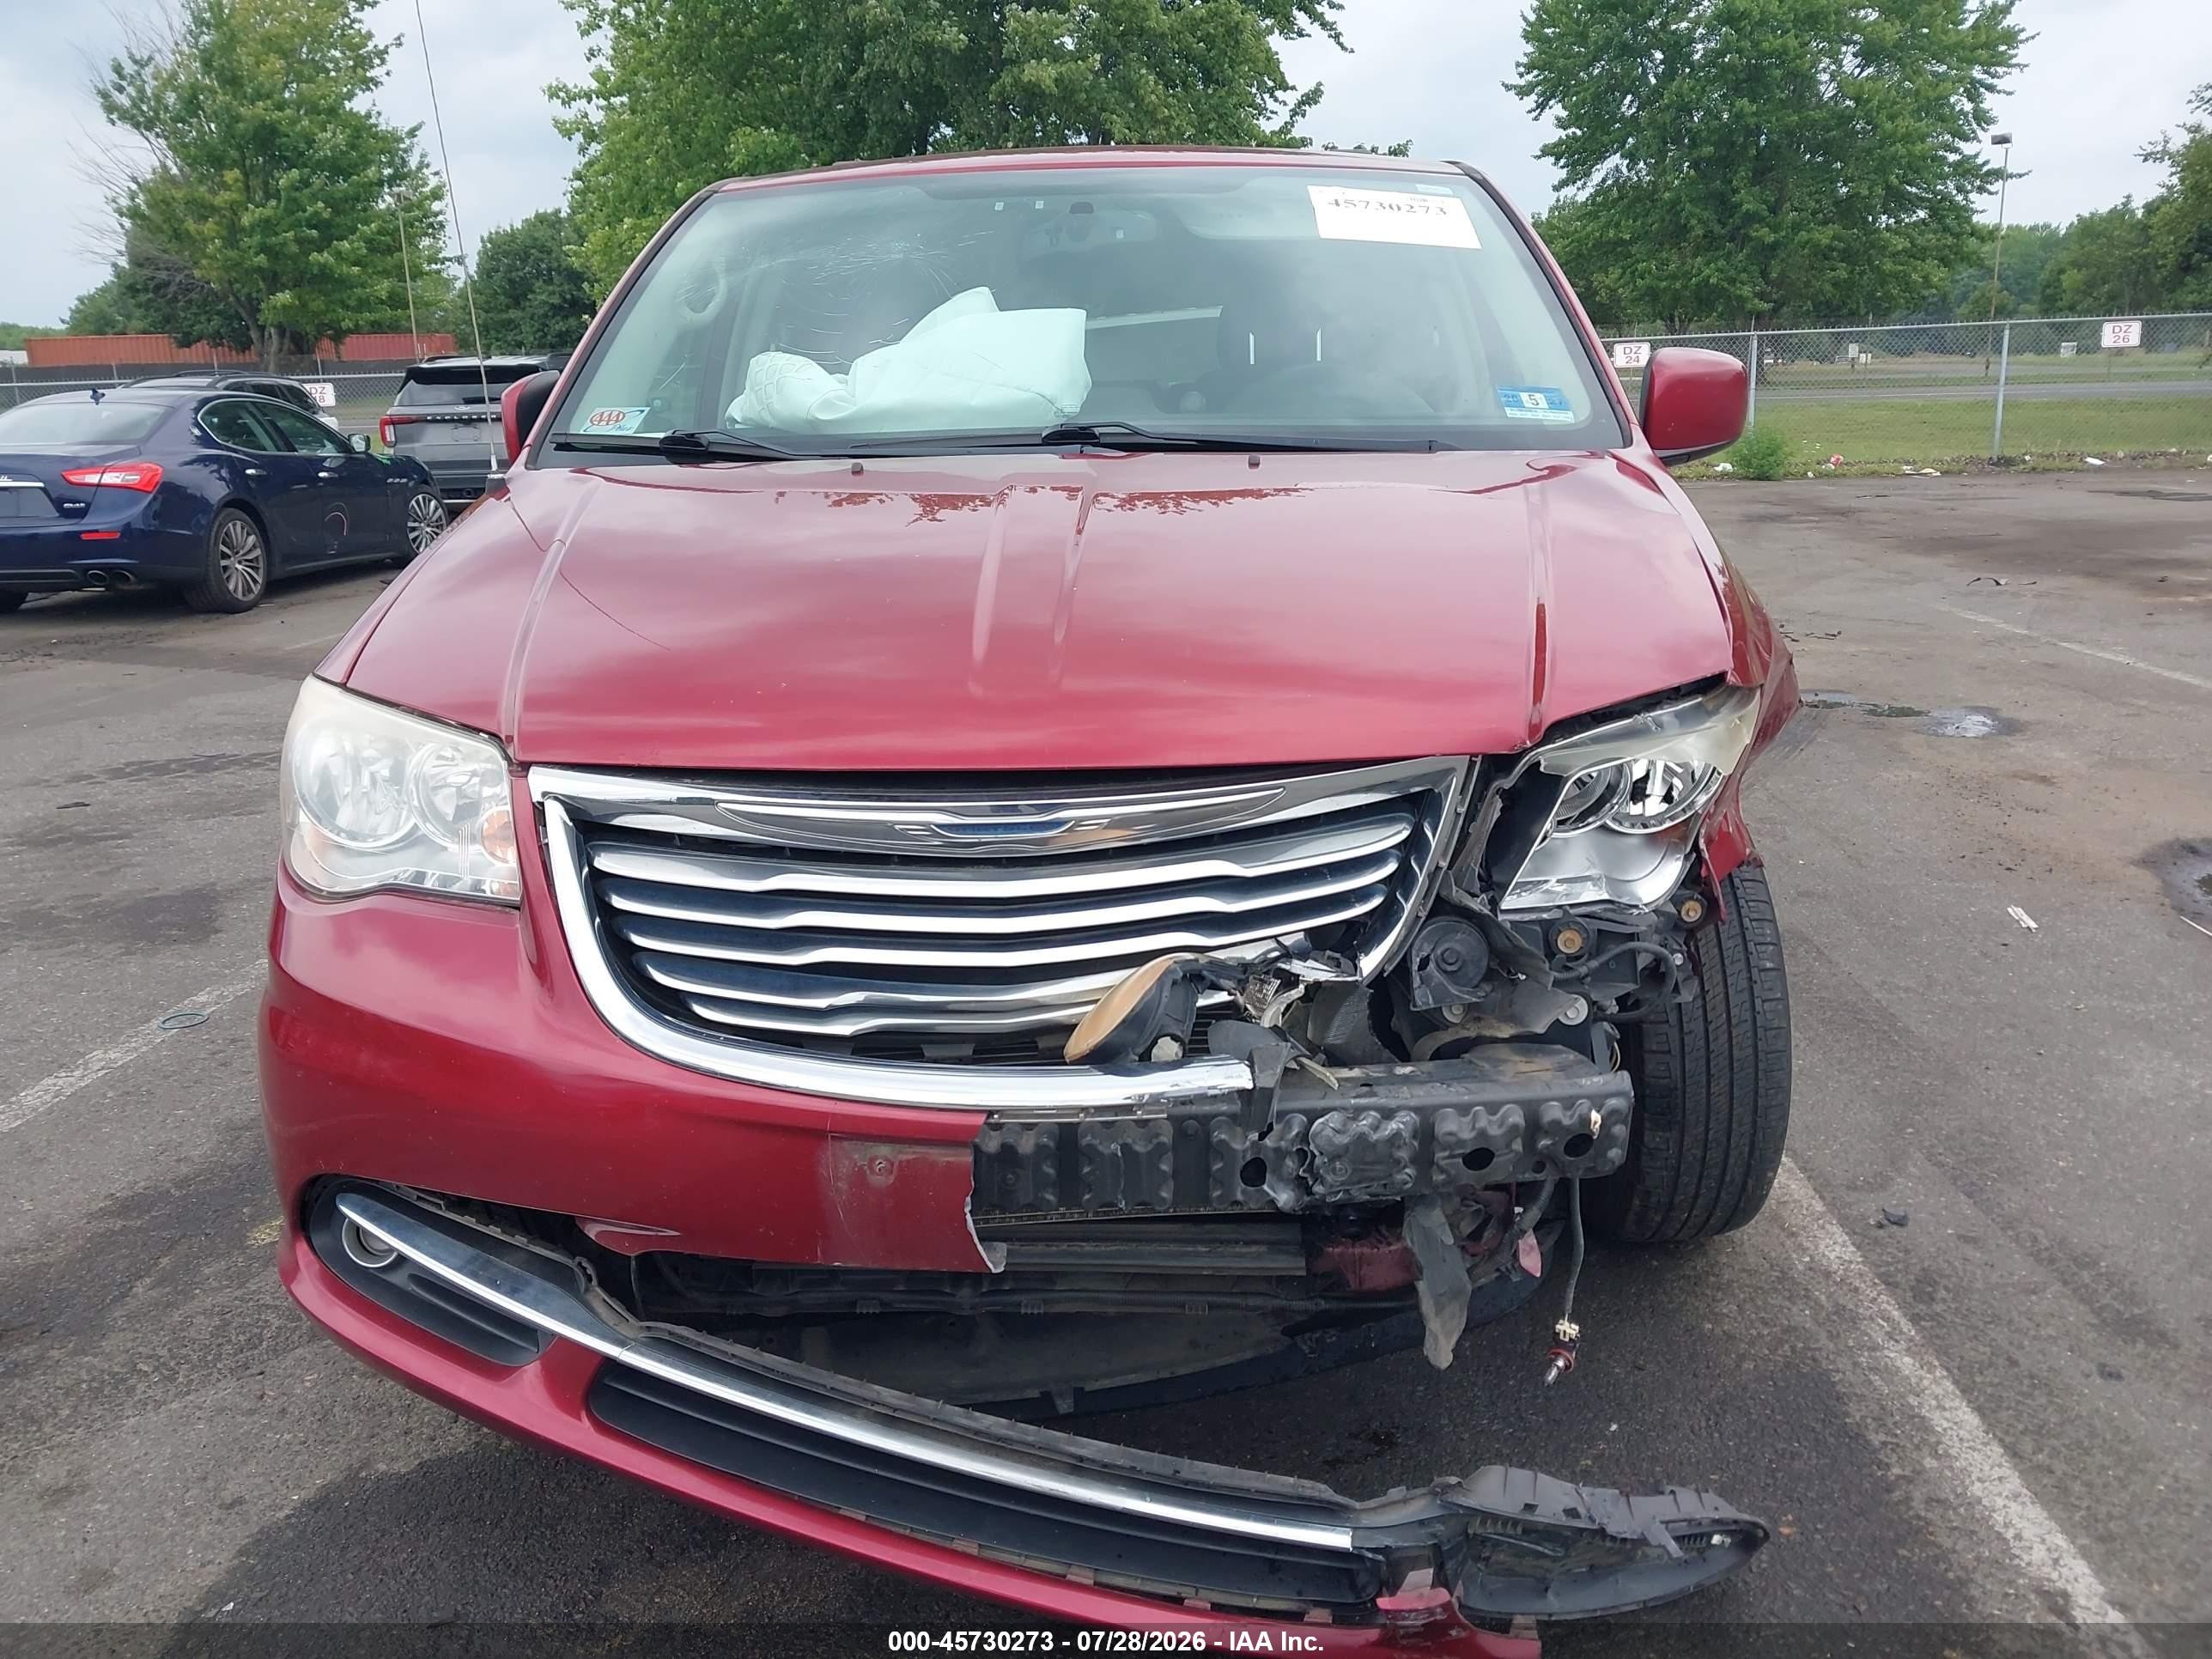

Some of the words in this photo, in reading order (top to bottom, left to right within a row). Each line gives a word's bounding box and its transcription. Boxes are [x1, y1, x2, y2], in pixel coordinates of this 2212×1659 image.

[1328, 198, 1448, 216] 45730273
[2112, 325, 2133, 334] DZ
[2112, 334, 2130, 343] 26
[1623, 345, 1643, 355] DZ
[1625, 356, 1639, 364] 24
[309, 386, 326, 395] DZ
[1528, 394, 1540, 406] 5
[592, 411, 622, 426] AAA
